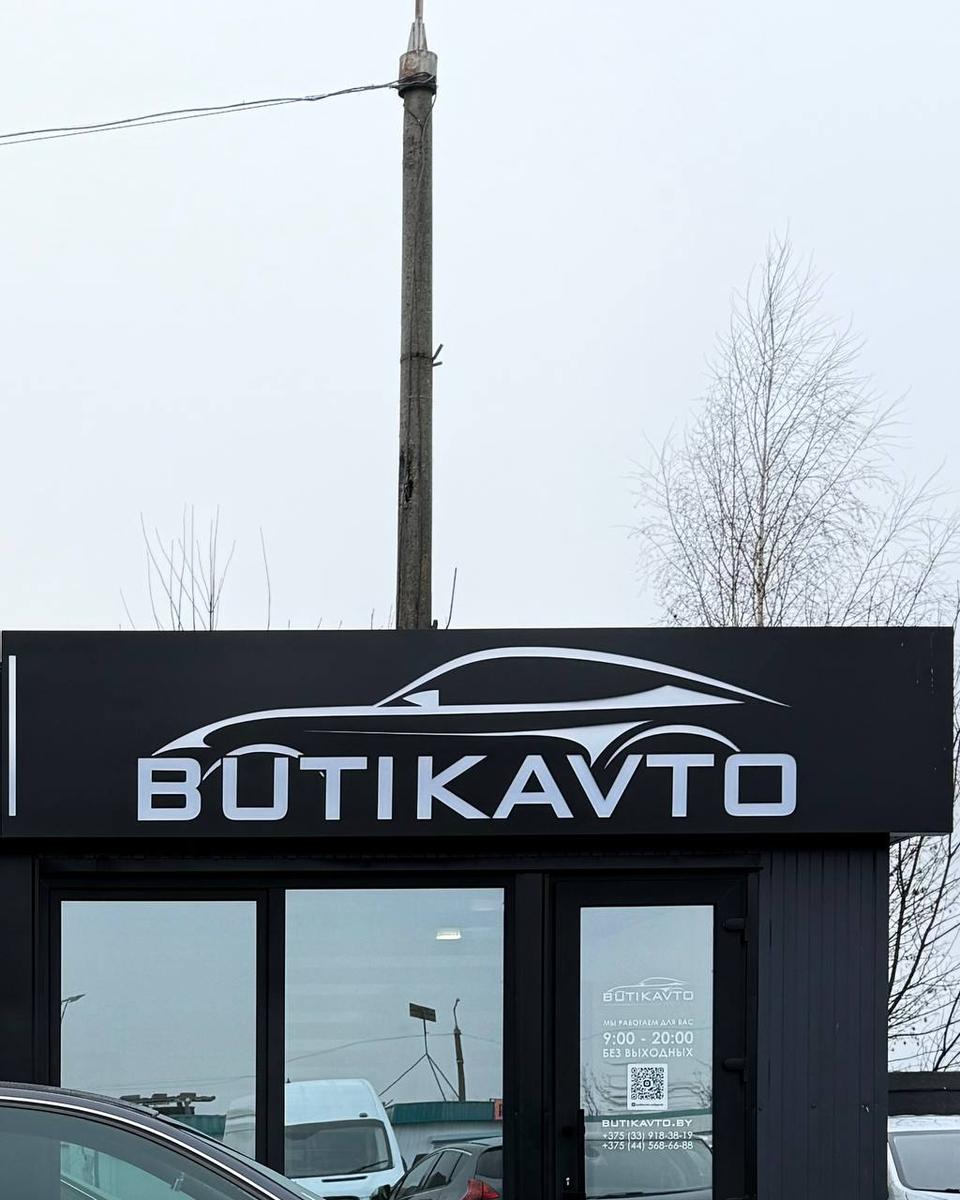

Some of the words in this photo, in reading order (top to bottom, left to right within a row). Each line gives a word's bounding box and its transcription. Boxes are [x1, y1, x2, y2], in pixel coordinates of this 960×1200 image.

[136, 751, 798, 822] BUTIKAVTO
[603, 990, 694, 1002] BUTIKAVTO
[603, 1031, 635, 1045] 9:00
[652, 1031, 694, 1045] 20:00
[603, 1048, 622, 1058] БЕЗ
[625, 1047, 694, 1058] ВЫХОДНЫХ
[602, 1119, 693, 1128] BUTIKAVTO.BY
[602, 1131, 625, 1140] +375
[627, 1131, 645, 1142] (33)
[648, 1131, 693, 1140] 918-38-19
[602, 1141, 625, 1150] +375
[627, 1141, 645, 1152] (44)
[648, 1141, 694, 1150] 568-66-88
